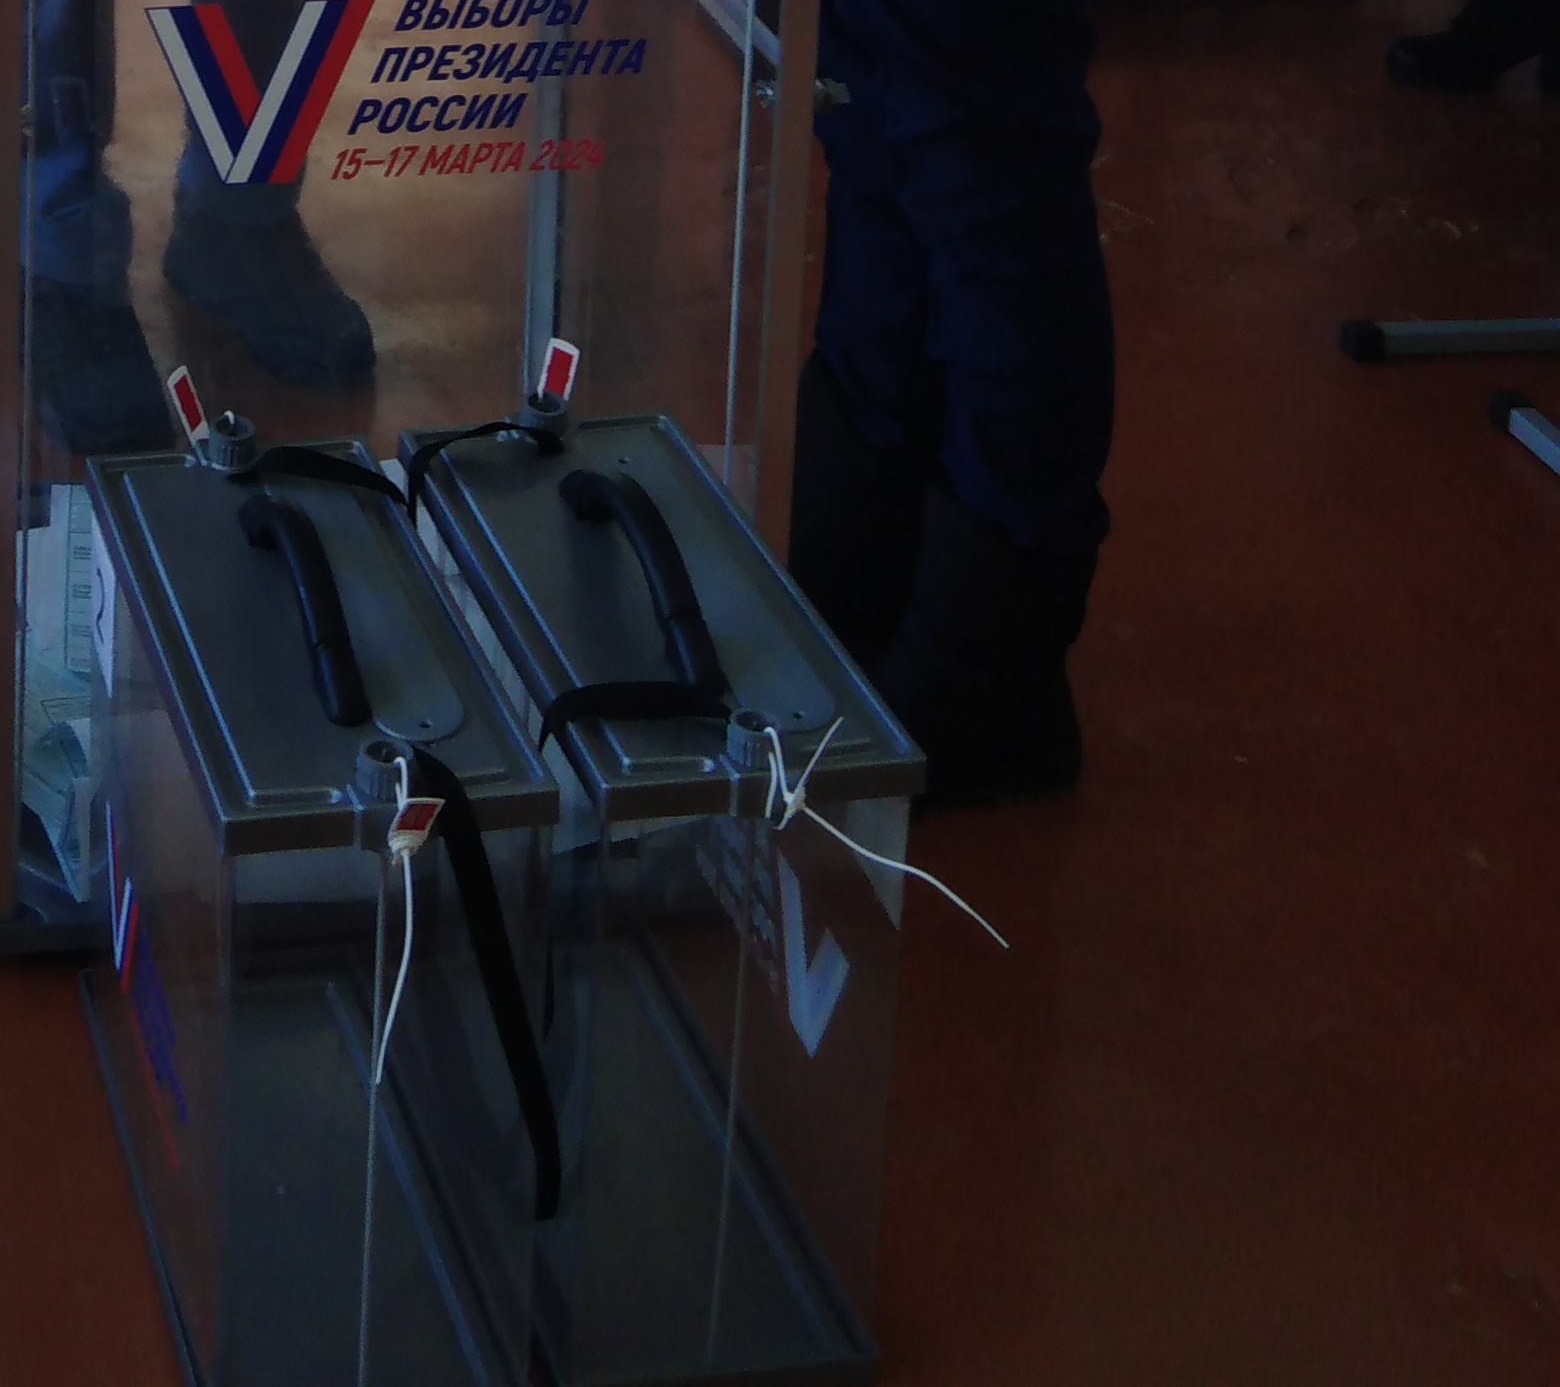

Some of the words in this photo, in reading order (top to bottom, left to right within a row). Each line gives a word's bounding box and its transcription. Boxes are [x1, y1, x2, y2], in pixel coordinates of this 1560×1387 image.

[370, 38, 647, 84] ПРЕЗИДЕНТА
[347, 92, 529, 135] РОССИИ
[418, 142, 526, 176] МАРТА
[528, 138, 605, 172] 2024
